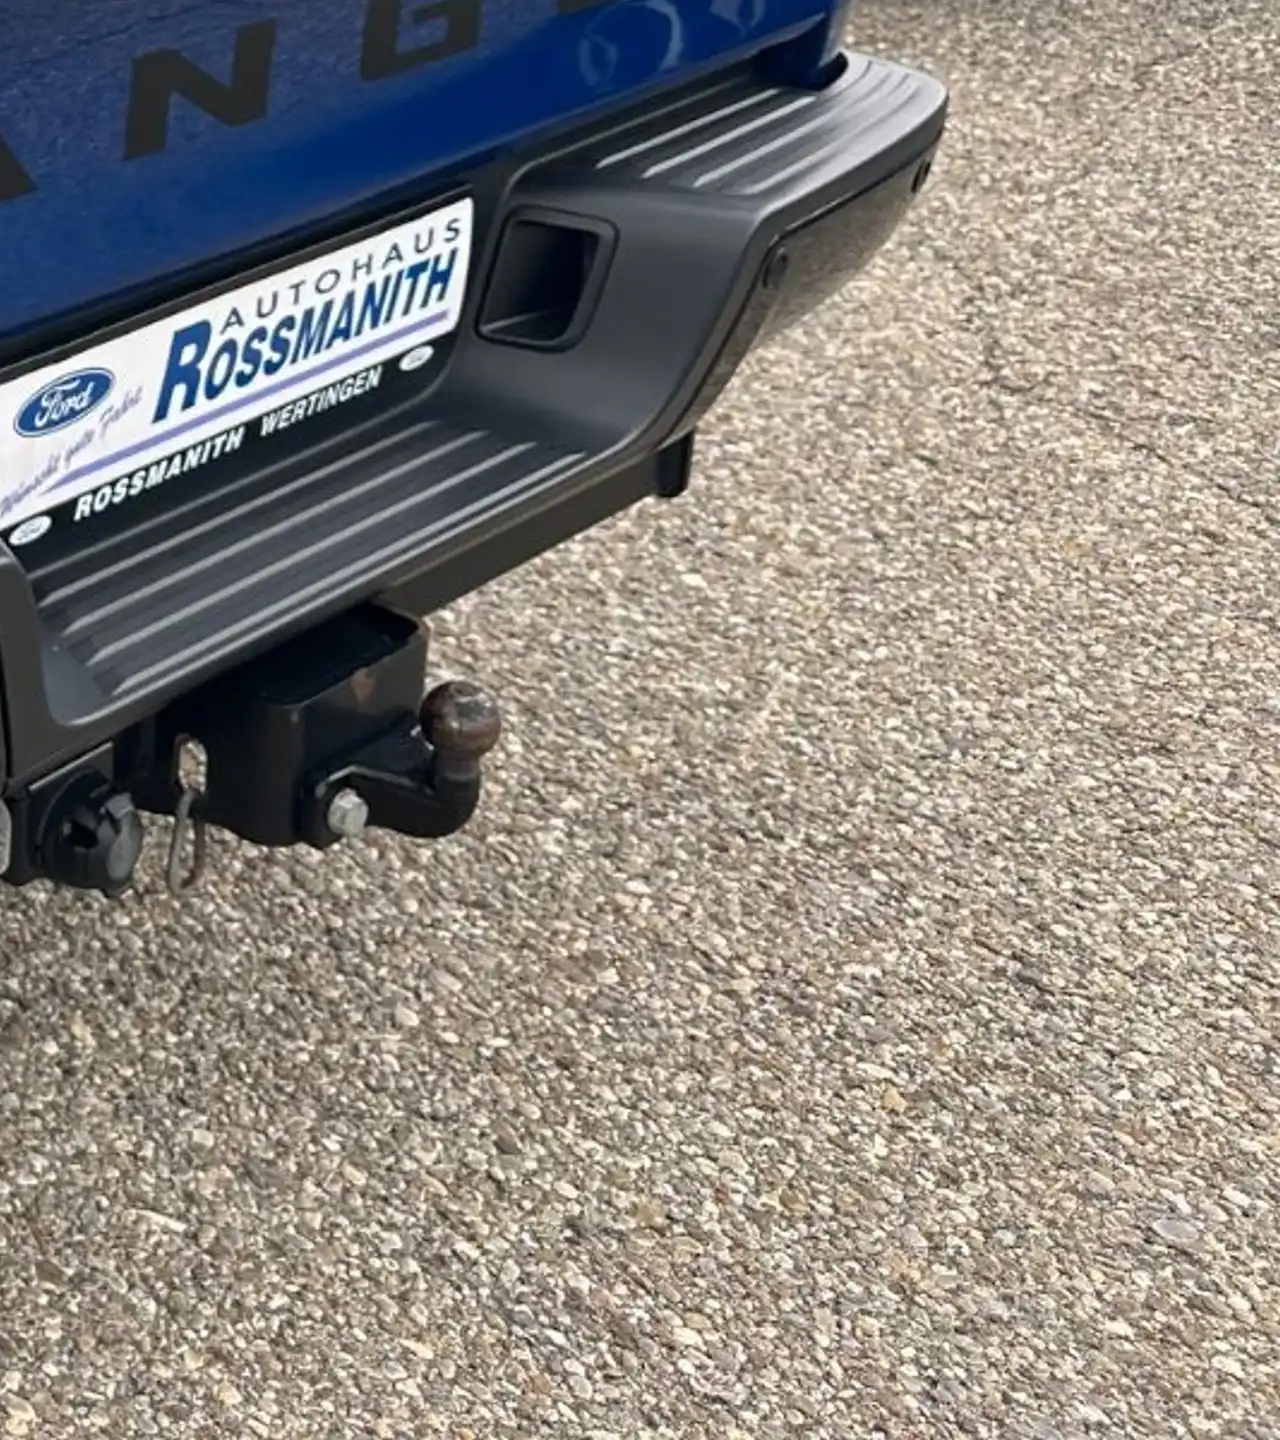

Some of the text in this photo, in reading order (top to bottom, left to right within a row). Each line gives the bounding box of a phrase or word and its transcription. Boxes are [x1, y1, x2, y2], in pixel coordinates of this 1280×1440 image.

[151, 247, 459, 424] ROSSMANITH
[219, 217, 461, 335] AUTOHAUS
[34, 378, 96, 428] Ford
[73, 363, 384, 522] ROSSMANITH WERTINGEN
